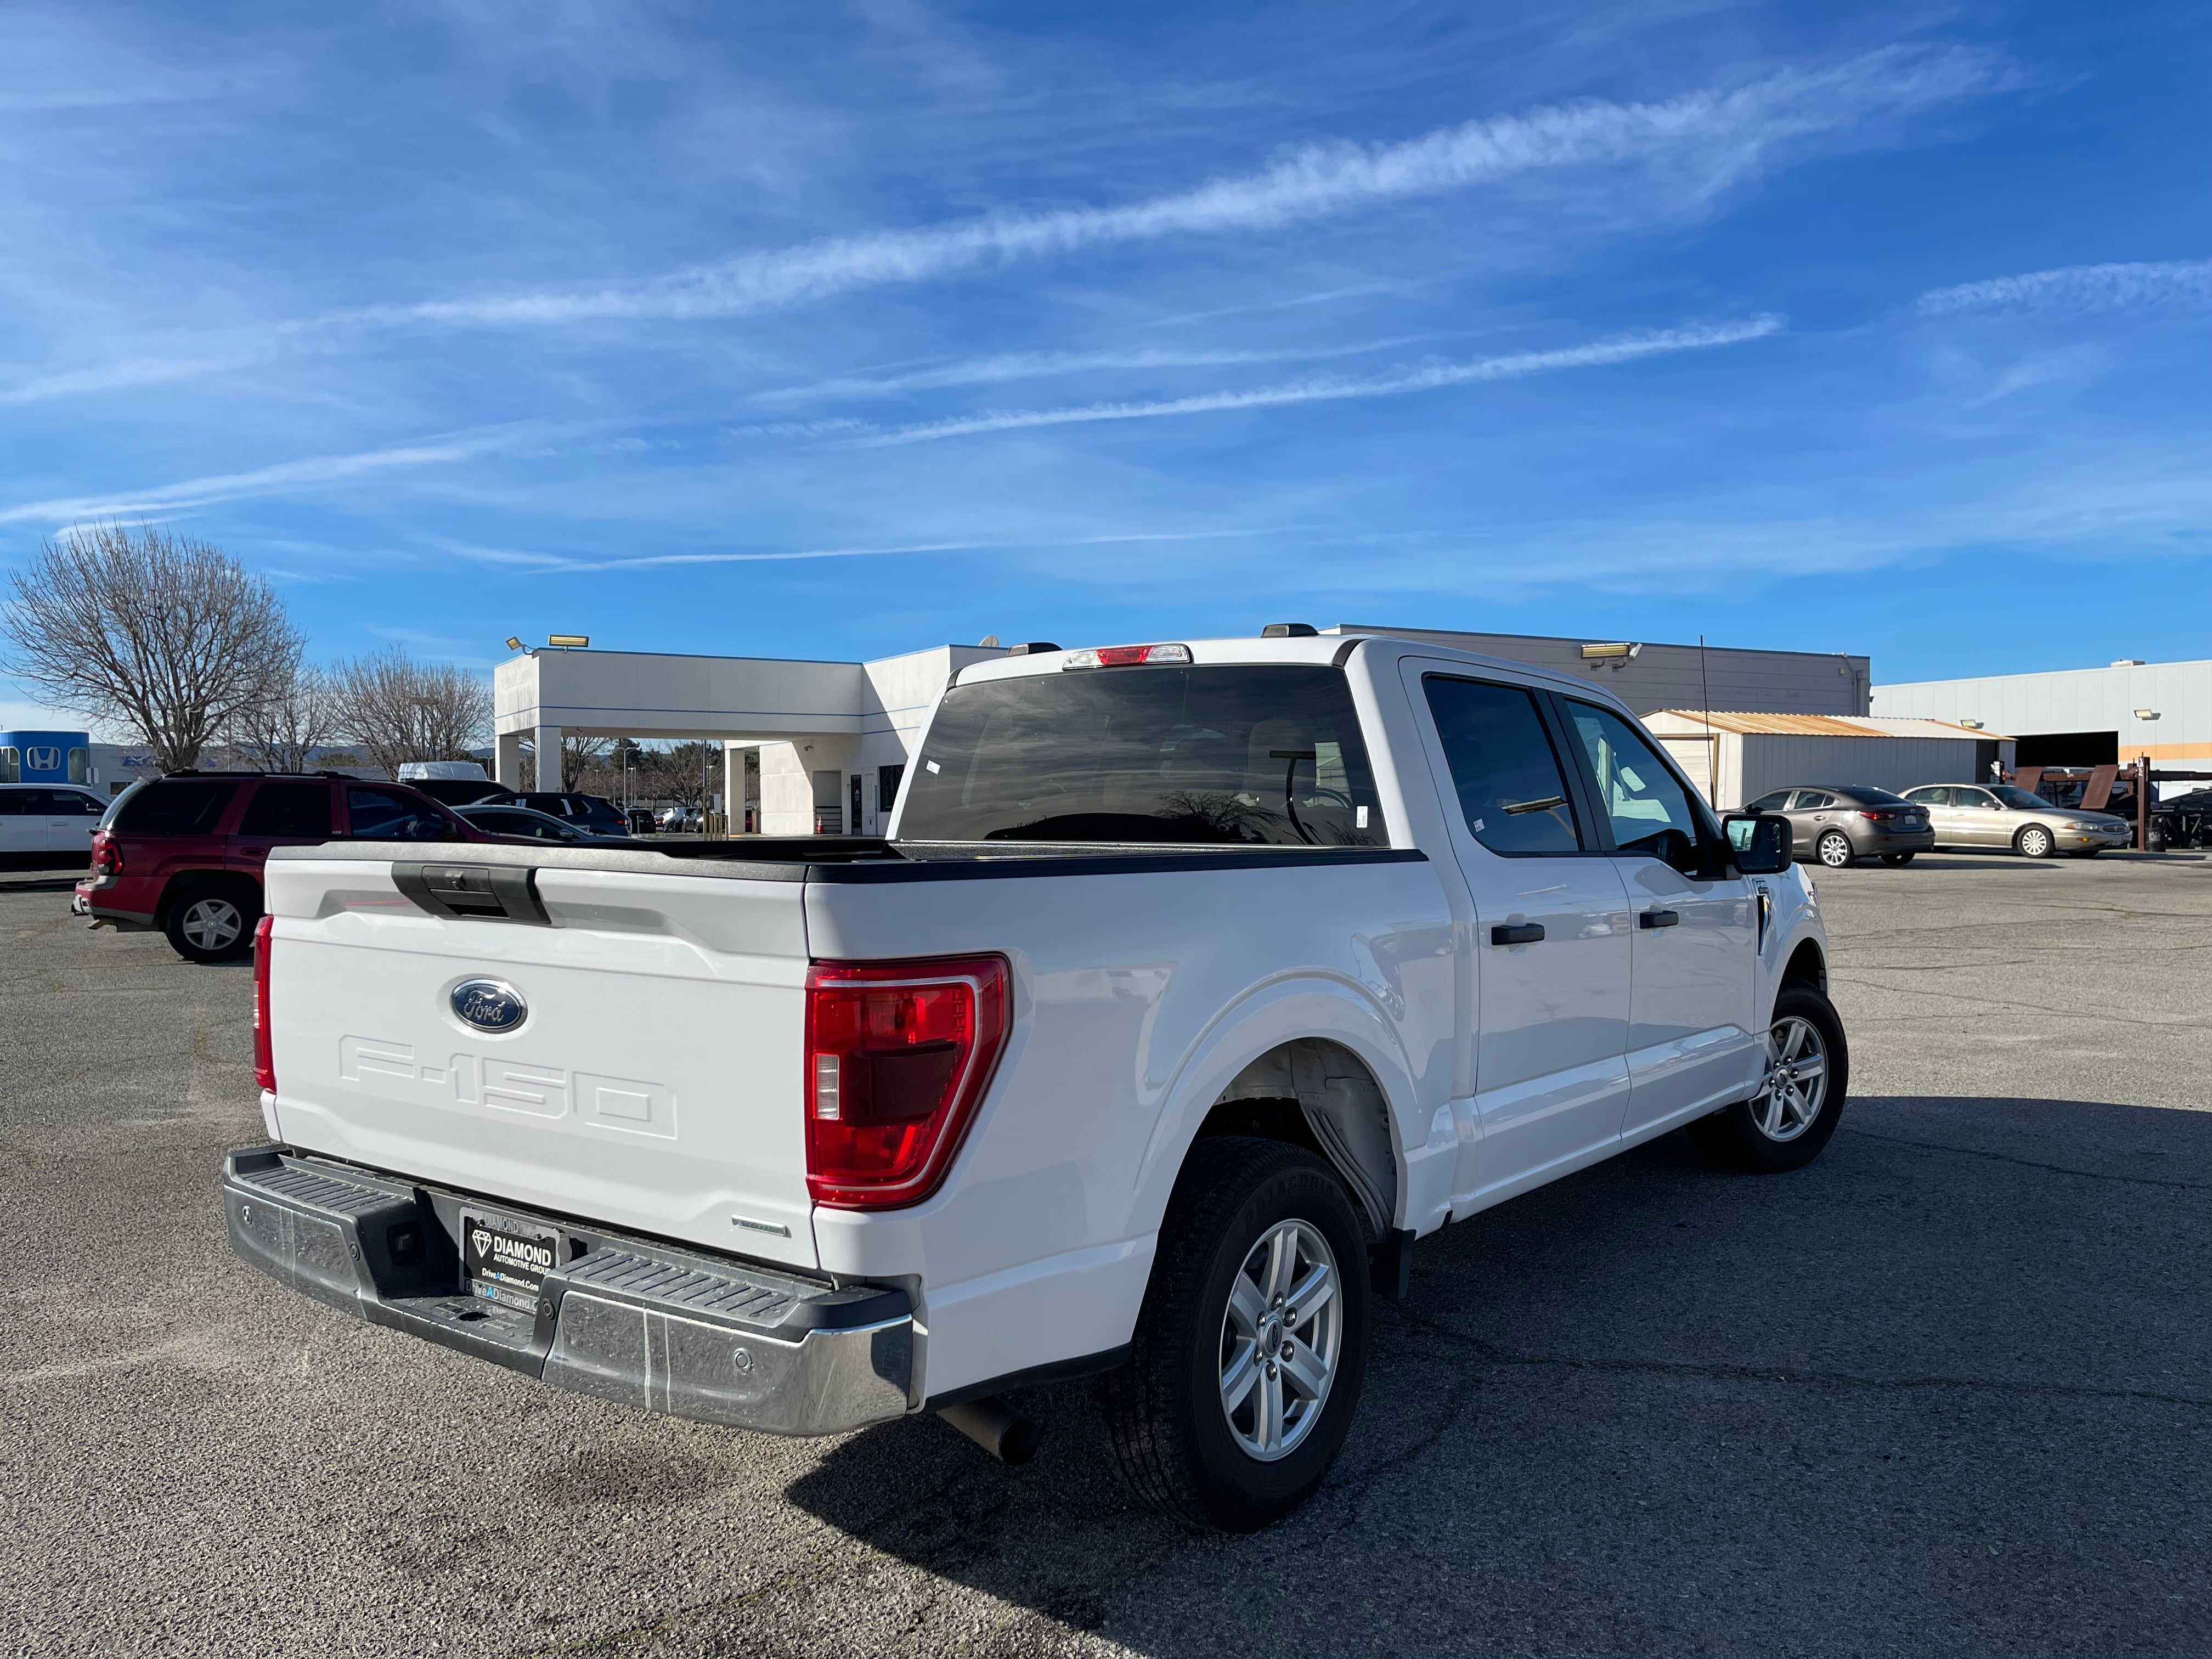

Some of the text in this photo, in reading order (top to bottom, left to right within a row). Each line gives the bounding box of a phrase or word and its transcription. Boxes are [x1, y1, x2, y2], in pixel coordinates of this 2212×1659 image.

[464, 990, 506, 1023] Ford
[338, 1034, 678, 1140] F-150
[484, 1214, 519, 1234] DIAMOND
[493, 1253, 529, 1271] AUTOMOTIVE
[494, 1235, 552, 1267] DIAMOND
[482, 1267, 539, 1292] DriveADiamond.Com
